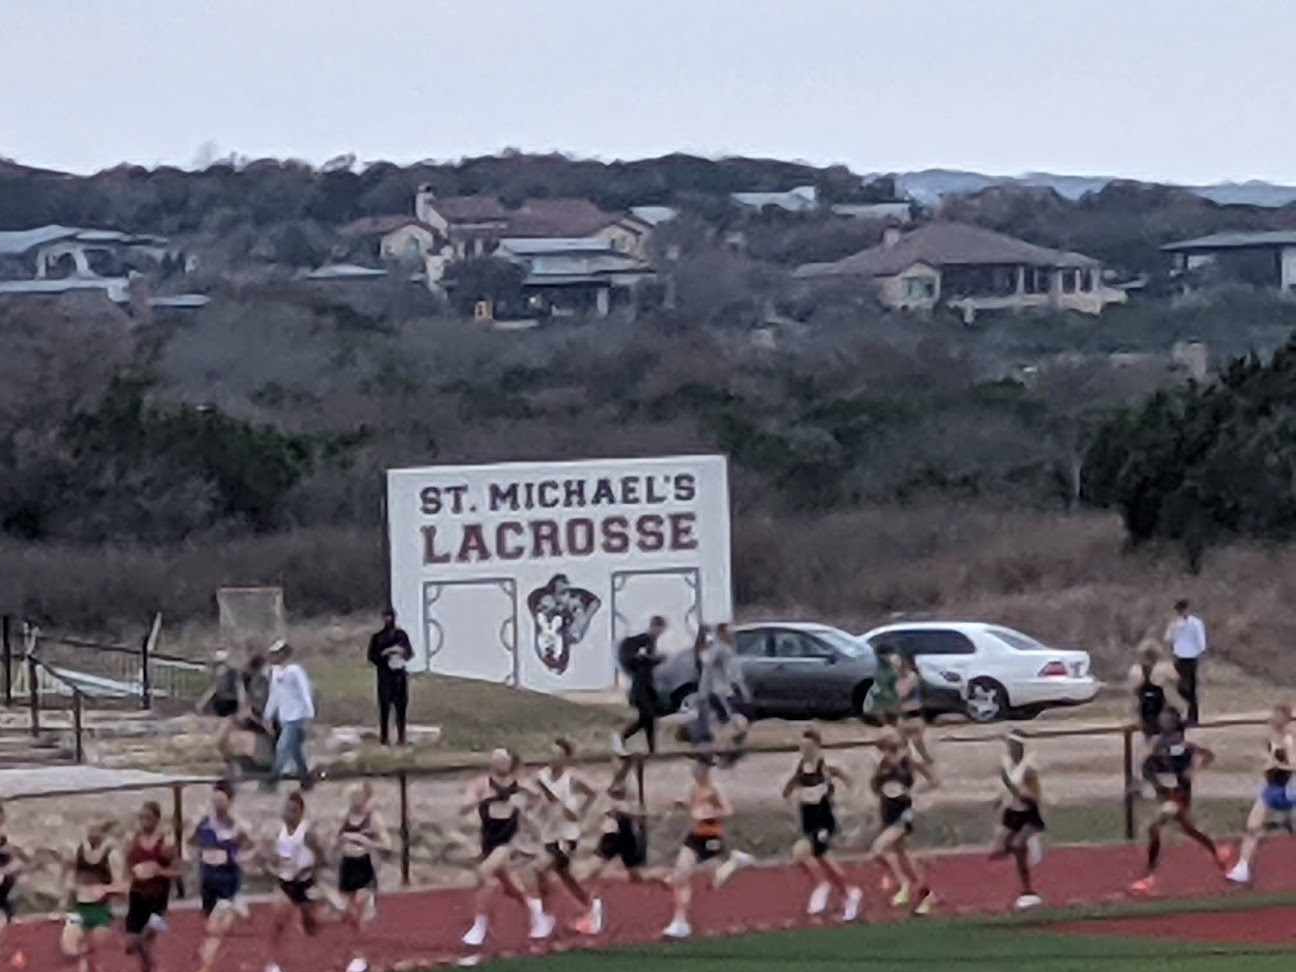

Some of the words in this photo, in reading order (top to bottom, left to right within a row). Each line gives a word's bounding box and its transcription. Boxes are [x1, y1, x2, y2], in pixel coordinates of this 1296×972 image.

[419, 485, 477, 516] ST.
[488, 473, 697, 512] MICHAEL'S
[422, 512, 699, 565] LACROSSE
